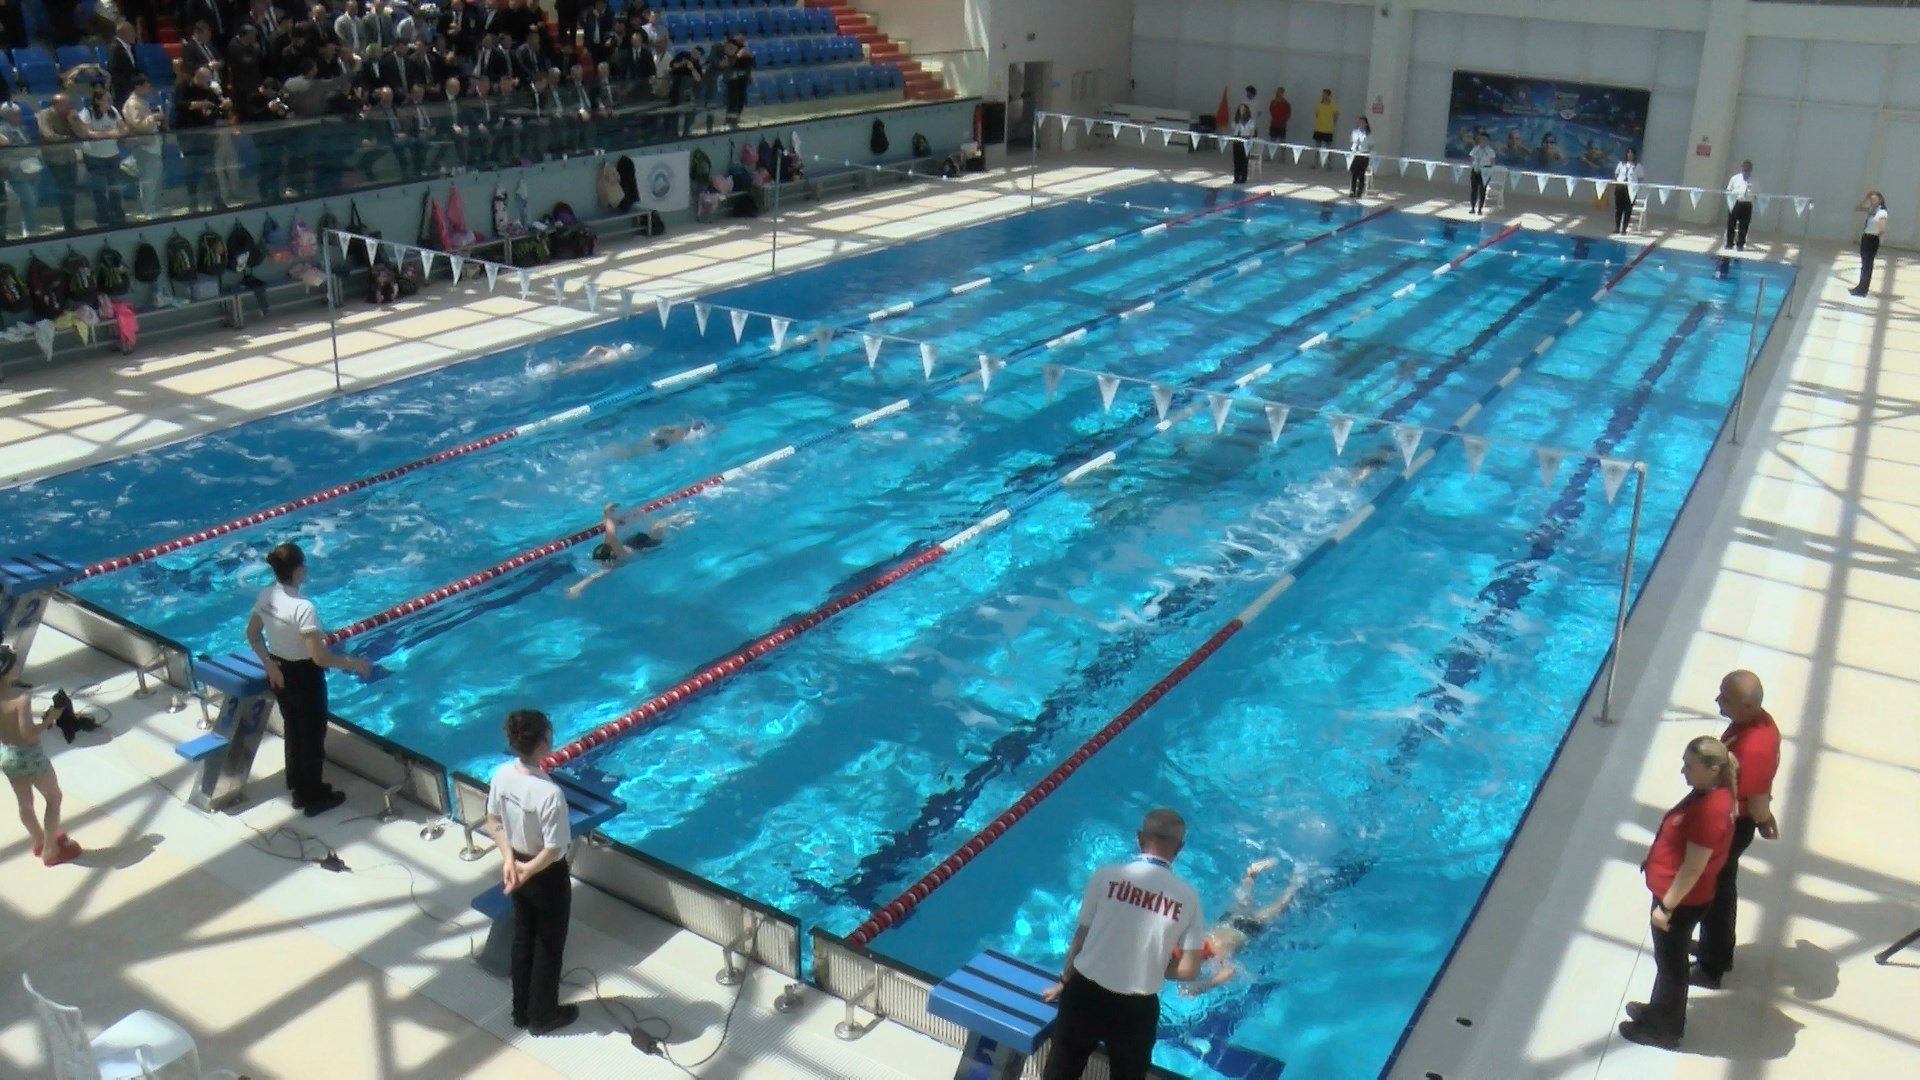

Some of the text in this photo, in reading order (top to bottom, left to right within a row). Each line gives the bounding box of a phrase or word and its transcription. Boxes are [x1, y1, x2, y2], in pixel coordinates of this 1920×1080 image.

[17, 598, 41, 629] 2
[240, 699, 266, 735] 3
[1107, 880, 1182, 921] TÜRKİYE
[970, 1035, 998, 1075] 5
